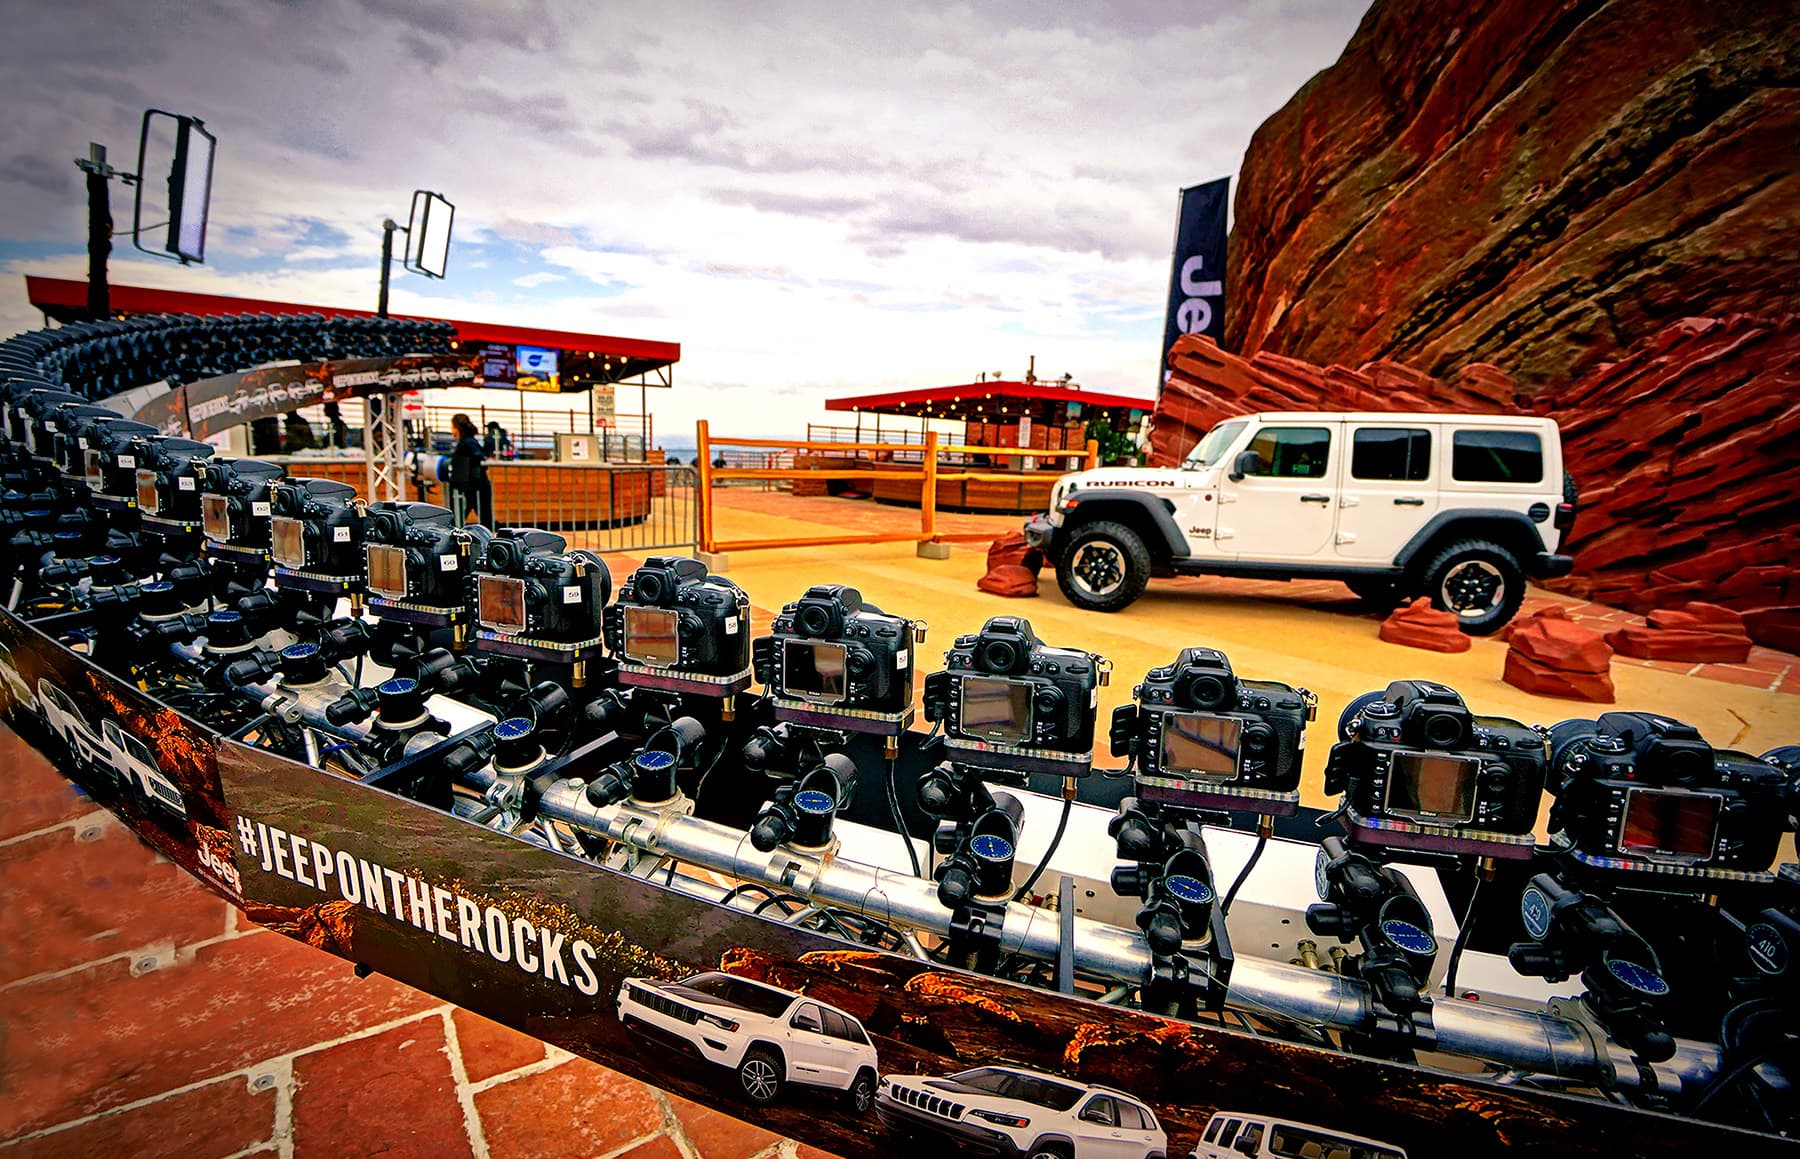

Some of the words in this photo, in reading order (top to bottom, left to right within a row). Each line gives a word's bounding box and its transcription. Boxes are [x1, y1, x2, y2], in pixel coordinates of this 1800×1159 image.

[1177, 255, 1223, 335] Je
[1189, 525, 1212, 535] Jeep
[236, 815, 599, 996] #JEEPONTHEROCKS
[1758, 939, 1776, 957] 410
